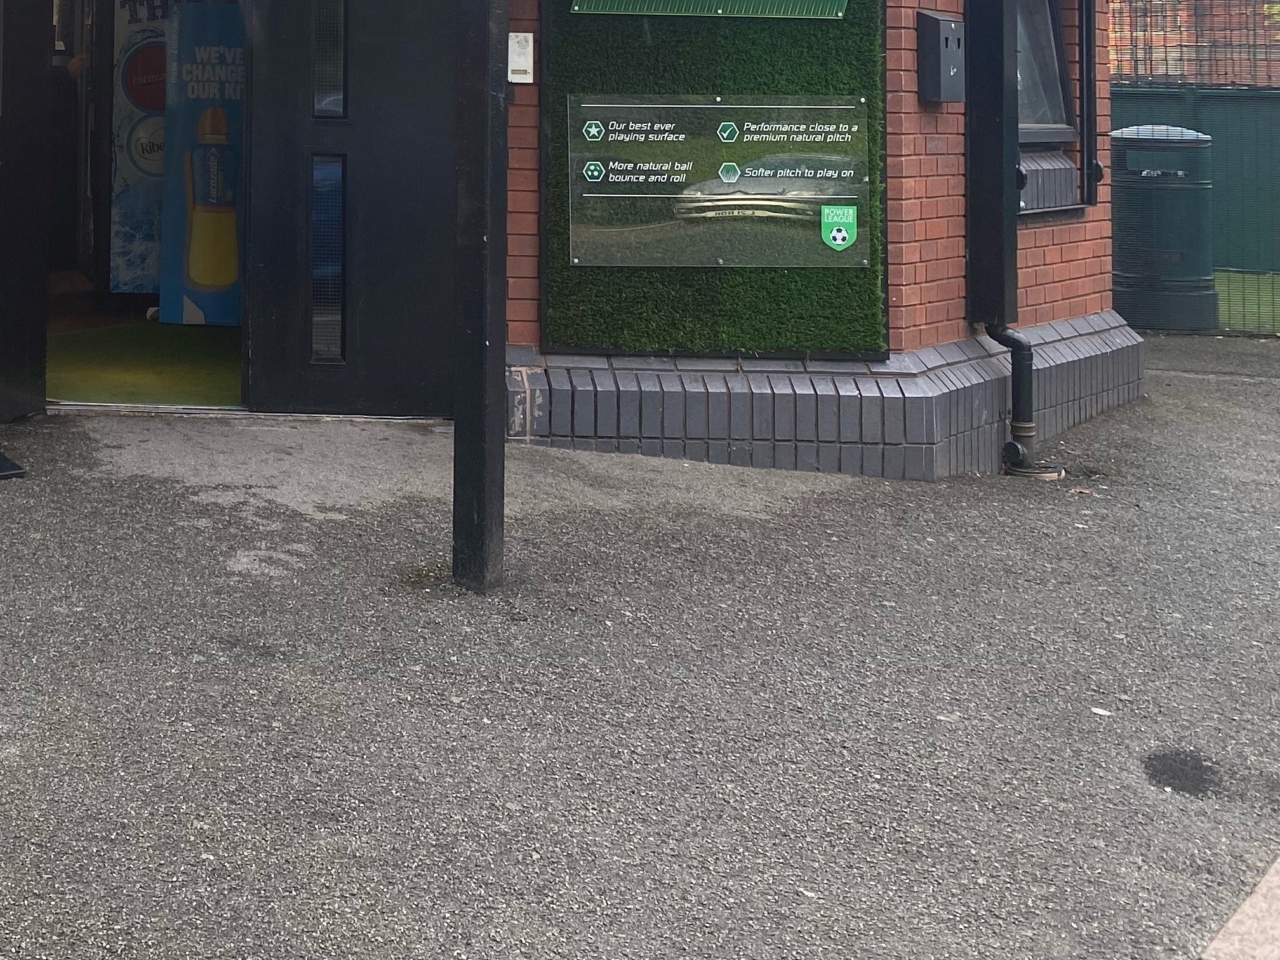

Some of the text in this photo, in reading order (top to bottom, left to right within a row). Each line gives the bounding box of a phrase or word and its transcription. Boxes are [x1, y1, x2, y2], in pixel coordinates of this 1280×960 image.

[195, 46, 245, 65] WE'VE
[188, 82, 221, 100] OUR
[608, 121, 676, 131] Our best ever
[743, 122, 859, 132] Performance close to a
[608, 131, 686, 142] playing surface
[743, 132, 852, 143] premium natural pitch
[608, 161, 693, 171] More natural ball
[608, 172, 687, 182] bounce and roll
[744, 167, 854, 179] Softer pitch to play on
[208, 155, 219, 203] Lucozade
[824, 207, 854, 216] POWER
[824, 214, 854, 223] LEAGUE
